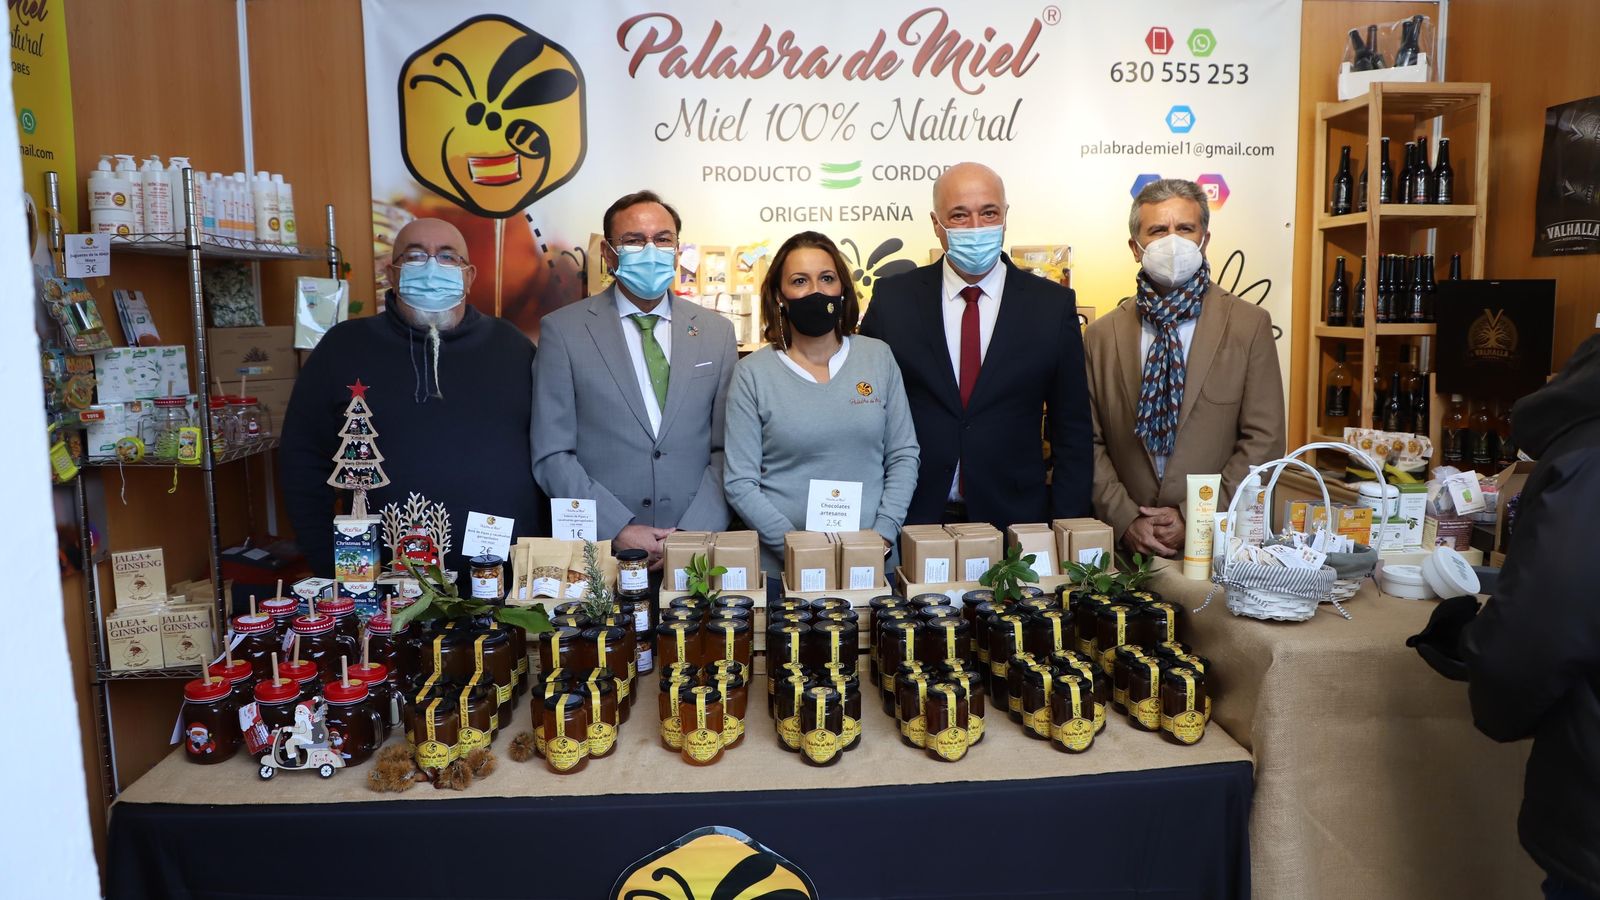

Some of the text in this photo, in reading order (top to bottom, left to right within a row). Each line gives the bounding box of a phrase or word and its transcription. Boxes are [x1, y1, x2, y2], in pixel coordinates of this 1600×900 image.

[616, 7, 1043, 96] Palabra de Miel
[1110, 61, 1249, 85] 630 555 253
[654, 98, 1024, 142] Miel 100% Natural
[1080, 140, 1274, 158] palabrademiel1@gmail.com
[702, 165, 812, 182] PRODUCTO
[760, 202, 914, 222] ORIGEN ESPAÑA
[1546, 222, 1600, 240] VALHALLA
[86, 264, 97, 274] 3€
[571, 529, 584, 540] 1€
[480, 546, 493, 554] 2€
[115, 554, 144, 564] JALEA
[116, 560, 161, 571] GINSENG
[109, 618, 140, 631] JALEA
[162, 614, 191, 625] JALEA
[111, 625, 158, 638] GINSENG
[164, 621, 208, 632] GINSENG
